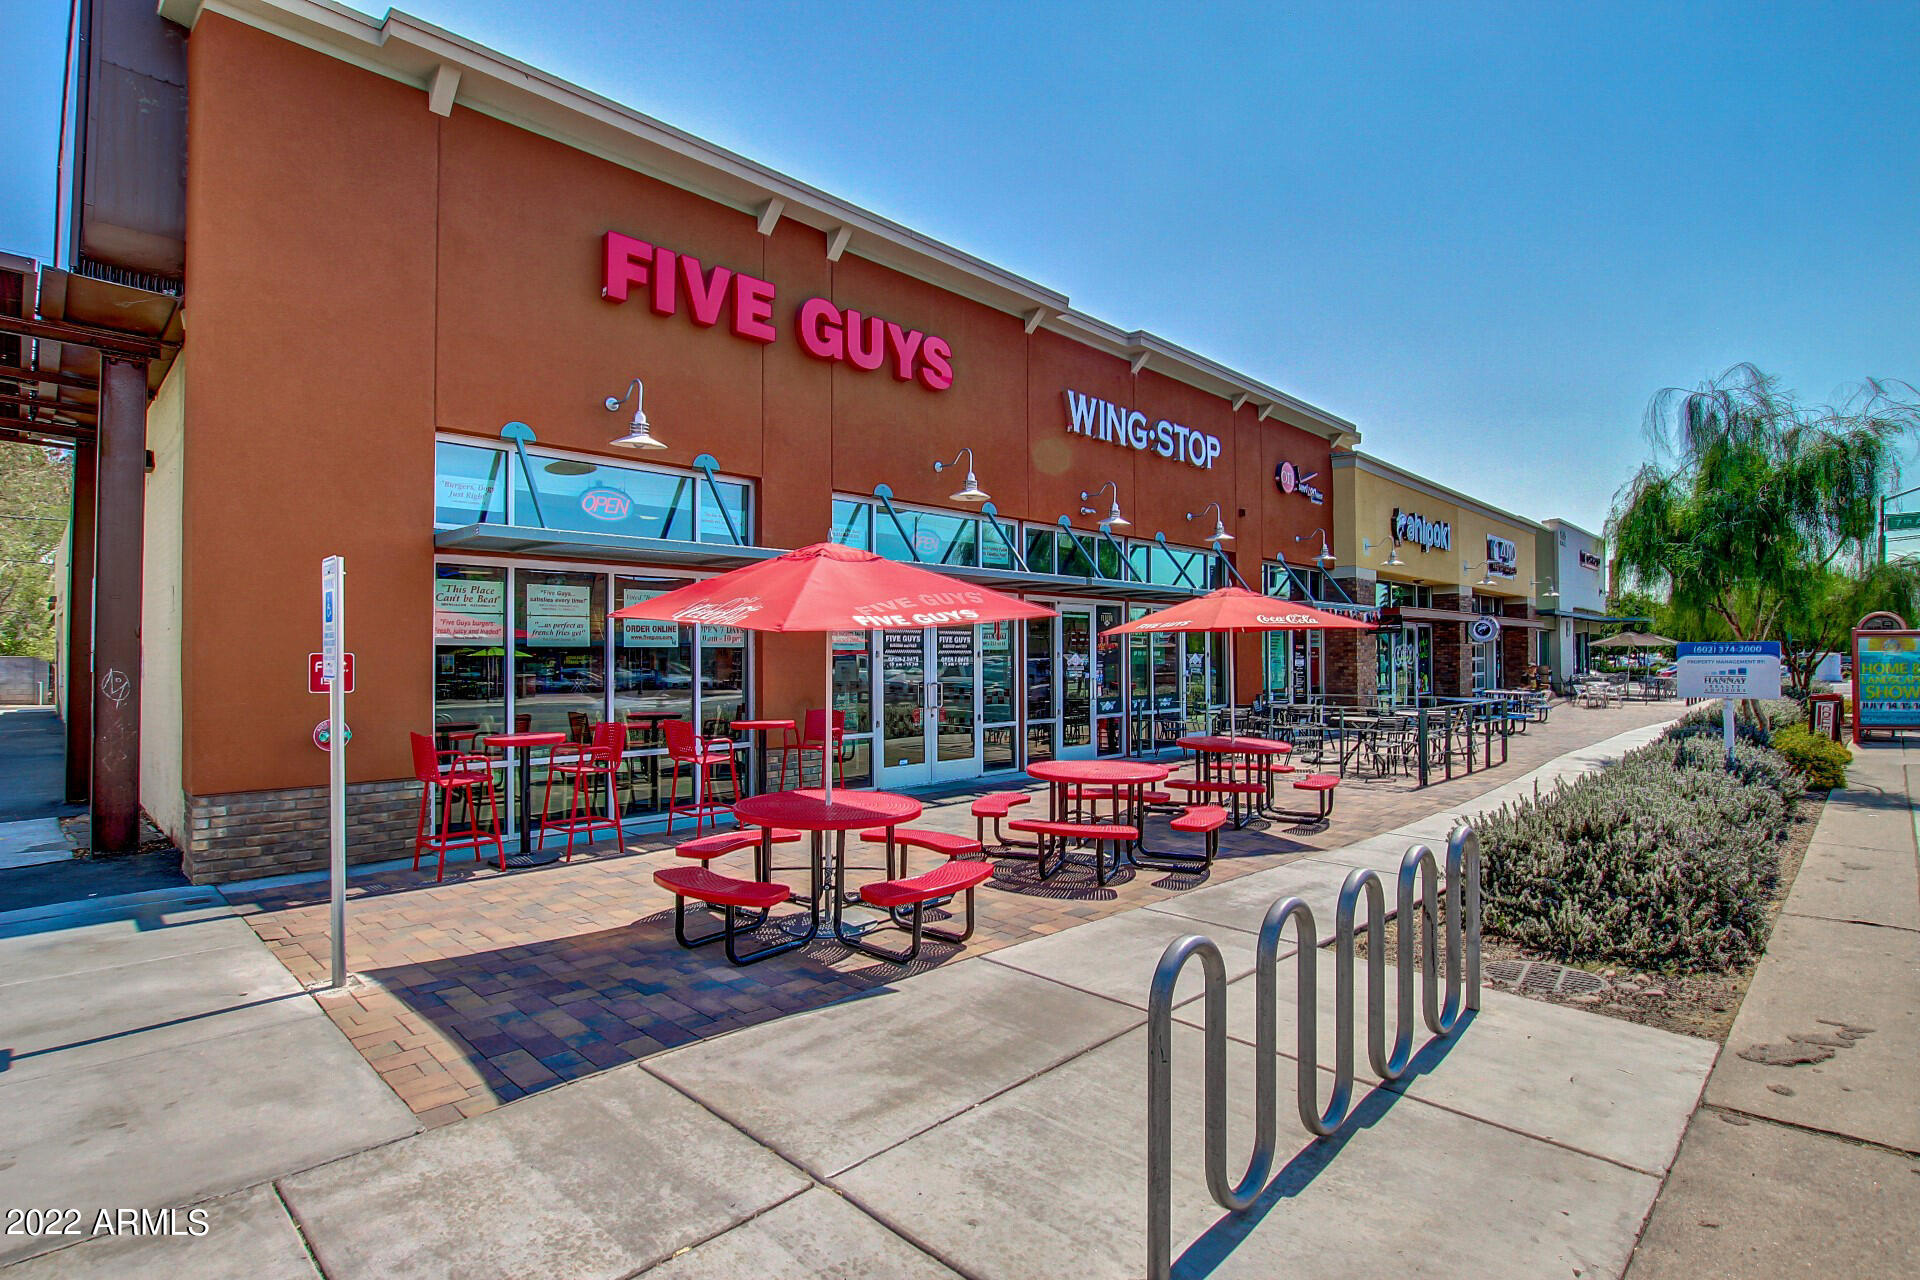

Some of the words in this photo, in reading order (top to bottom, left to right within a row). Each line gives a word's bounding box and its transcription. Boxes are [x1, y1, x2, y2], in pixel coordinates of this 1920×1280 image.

[600, 230, 776, 344] FIVE
[795, 297, 953, 392] GUYS
[582, 495, 630, 515] OPEN
[470, 586, 495, 594] Place
[464, 594, 473, 603] be
[854, 597, 918, 615] FIVE
[918, 591, 984, 606] GUYS
[852, 614, 913, 626] FIVE
[912, 609, 979, 625] GUYS
[552, 622, 576, 630] perfect
[625, 625, 650, 633] ORDER
[652, 625, 677, 633] ONLINE
[885, 634, 901, 642] FIVE
[902, 635, 921, 643] GUYS
[954, 636, 971, 644] GUYS
[1693, 645, 1716, 654] (602)
[1718, 645, 1762, 653] 374-2000
[1862, 663, 1907, 674] HOME
[1704, 676, 1746, 684] HANNAY
[1865, 685, 1920, 699] SHOW
